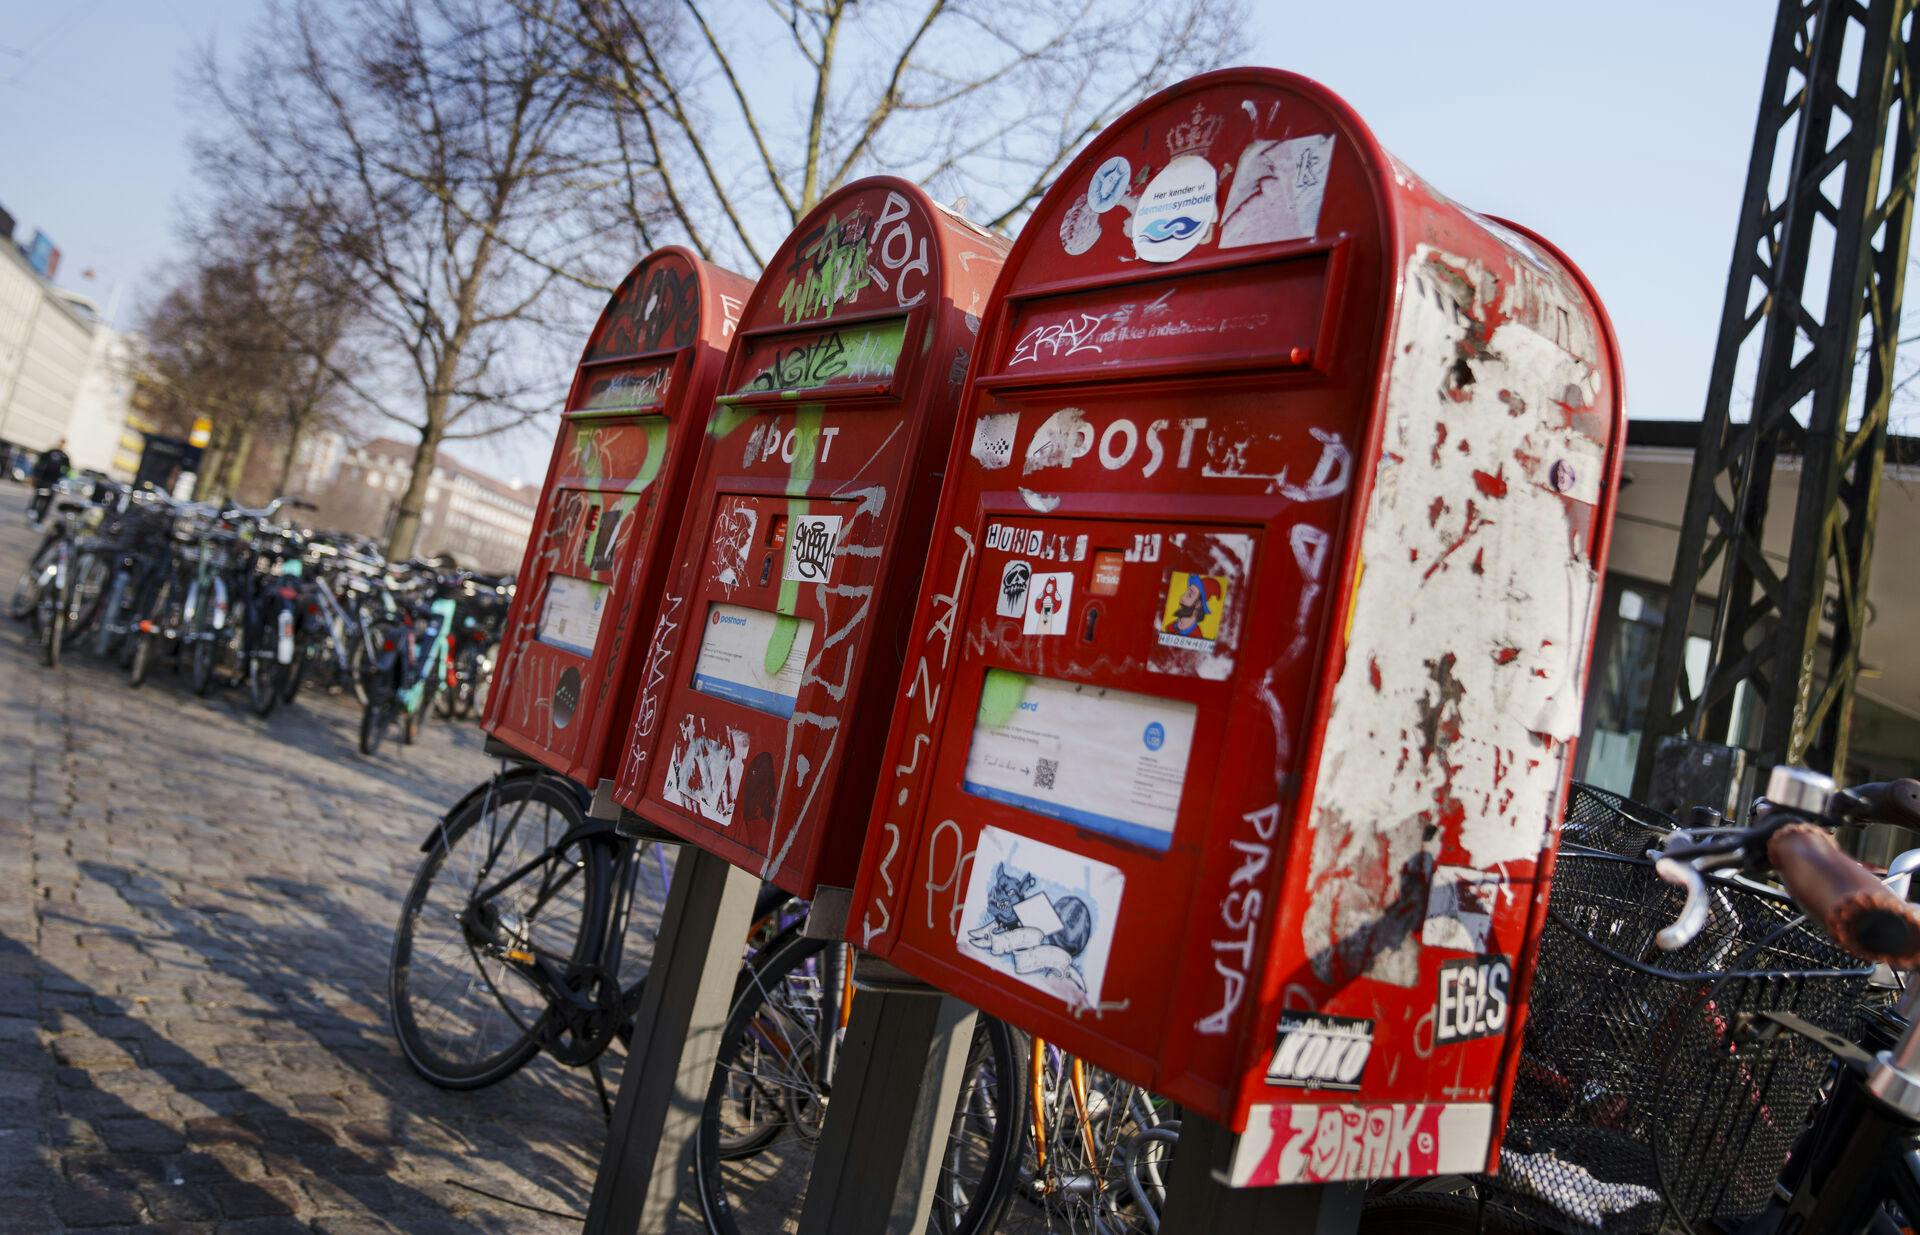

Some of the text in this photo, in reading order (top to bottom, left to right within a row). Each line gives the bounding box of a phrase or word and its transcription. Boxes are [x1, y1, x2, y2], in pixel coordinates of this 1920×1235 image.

[1153, 182, 1206, 200] Her kender vi
[762, 425, 840, 470] POST
[1061, 418, 1208, 478] POST
[719, 614, 748, 627] postnord
[1194, 802, 1280, 1036] PASTA
